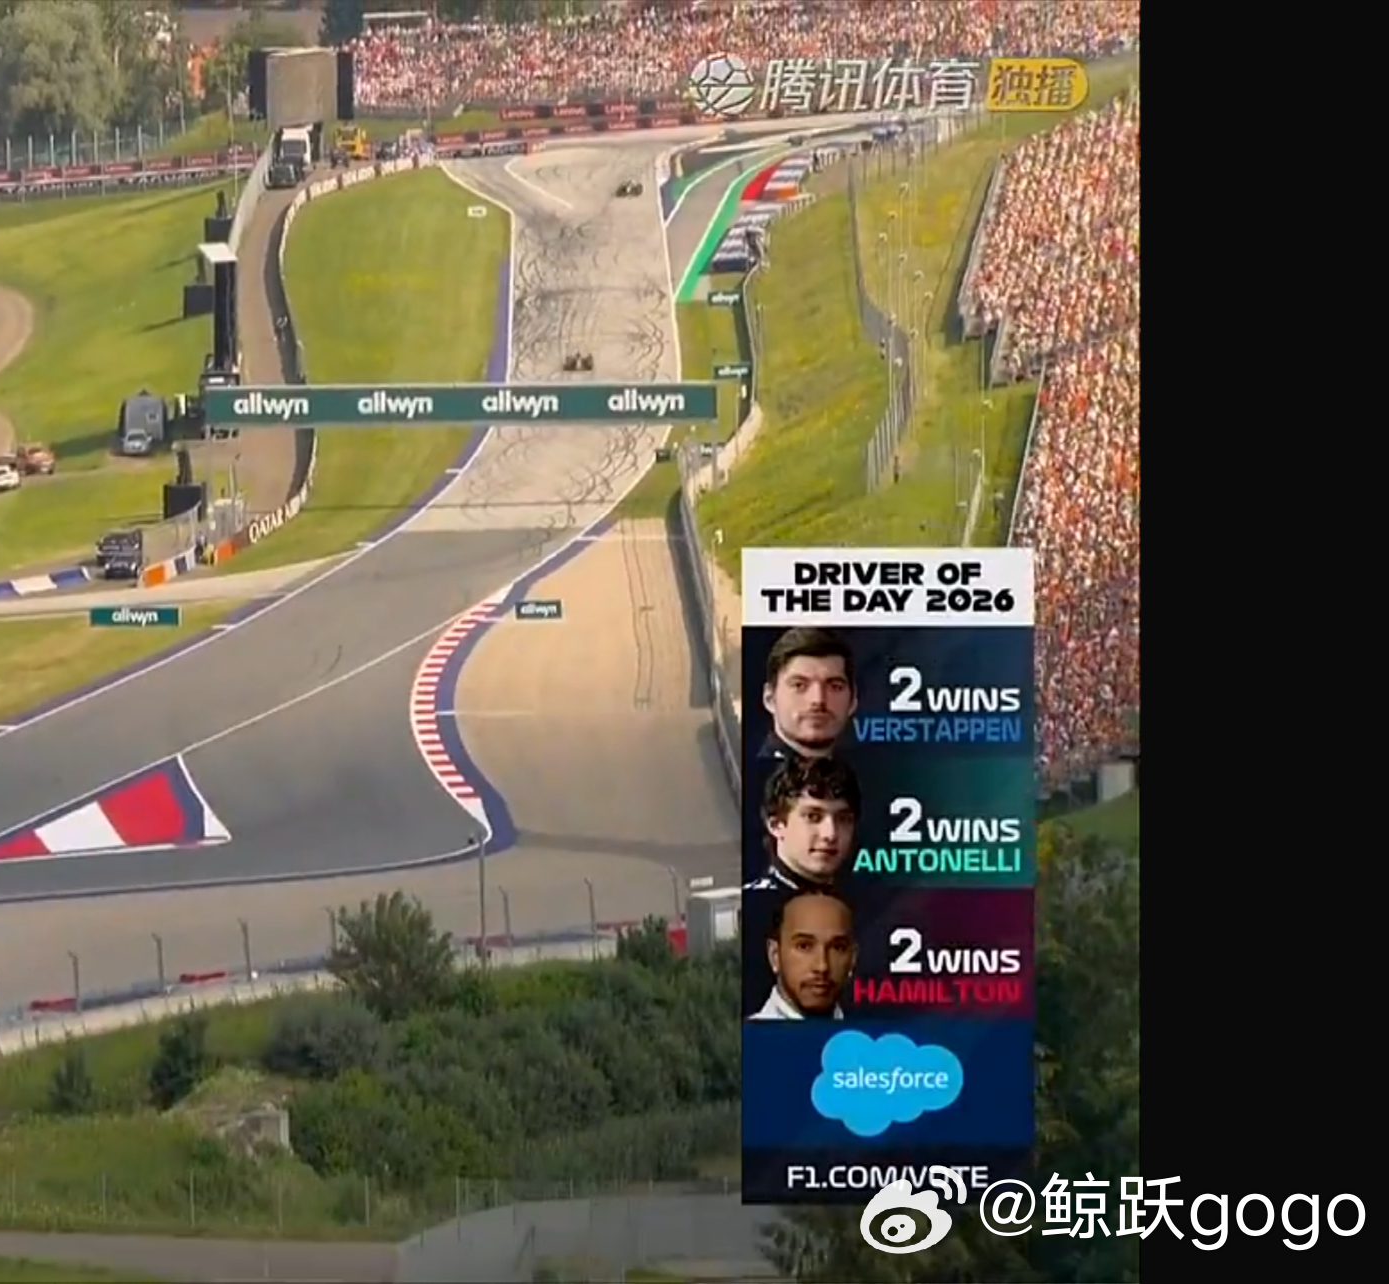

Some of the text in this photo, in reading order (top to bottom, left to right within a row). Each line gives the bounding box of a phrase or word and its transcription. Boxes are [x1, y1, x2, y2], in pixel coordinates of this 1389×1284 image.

[234, 392, 309, 420] allwyn
[358, 392, 433, 418] allwyn
[482, 391, 558, 417] allwyn
[608, 389, 685, 416] allwyn
[112, 607, 159, 628] allwyn
